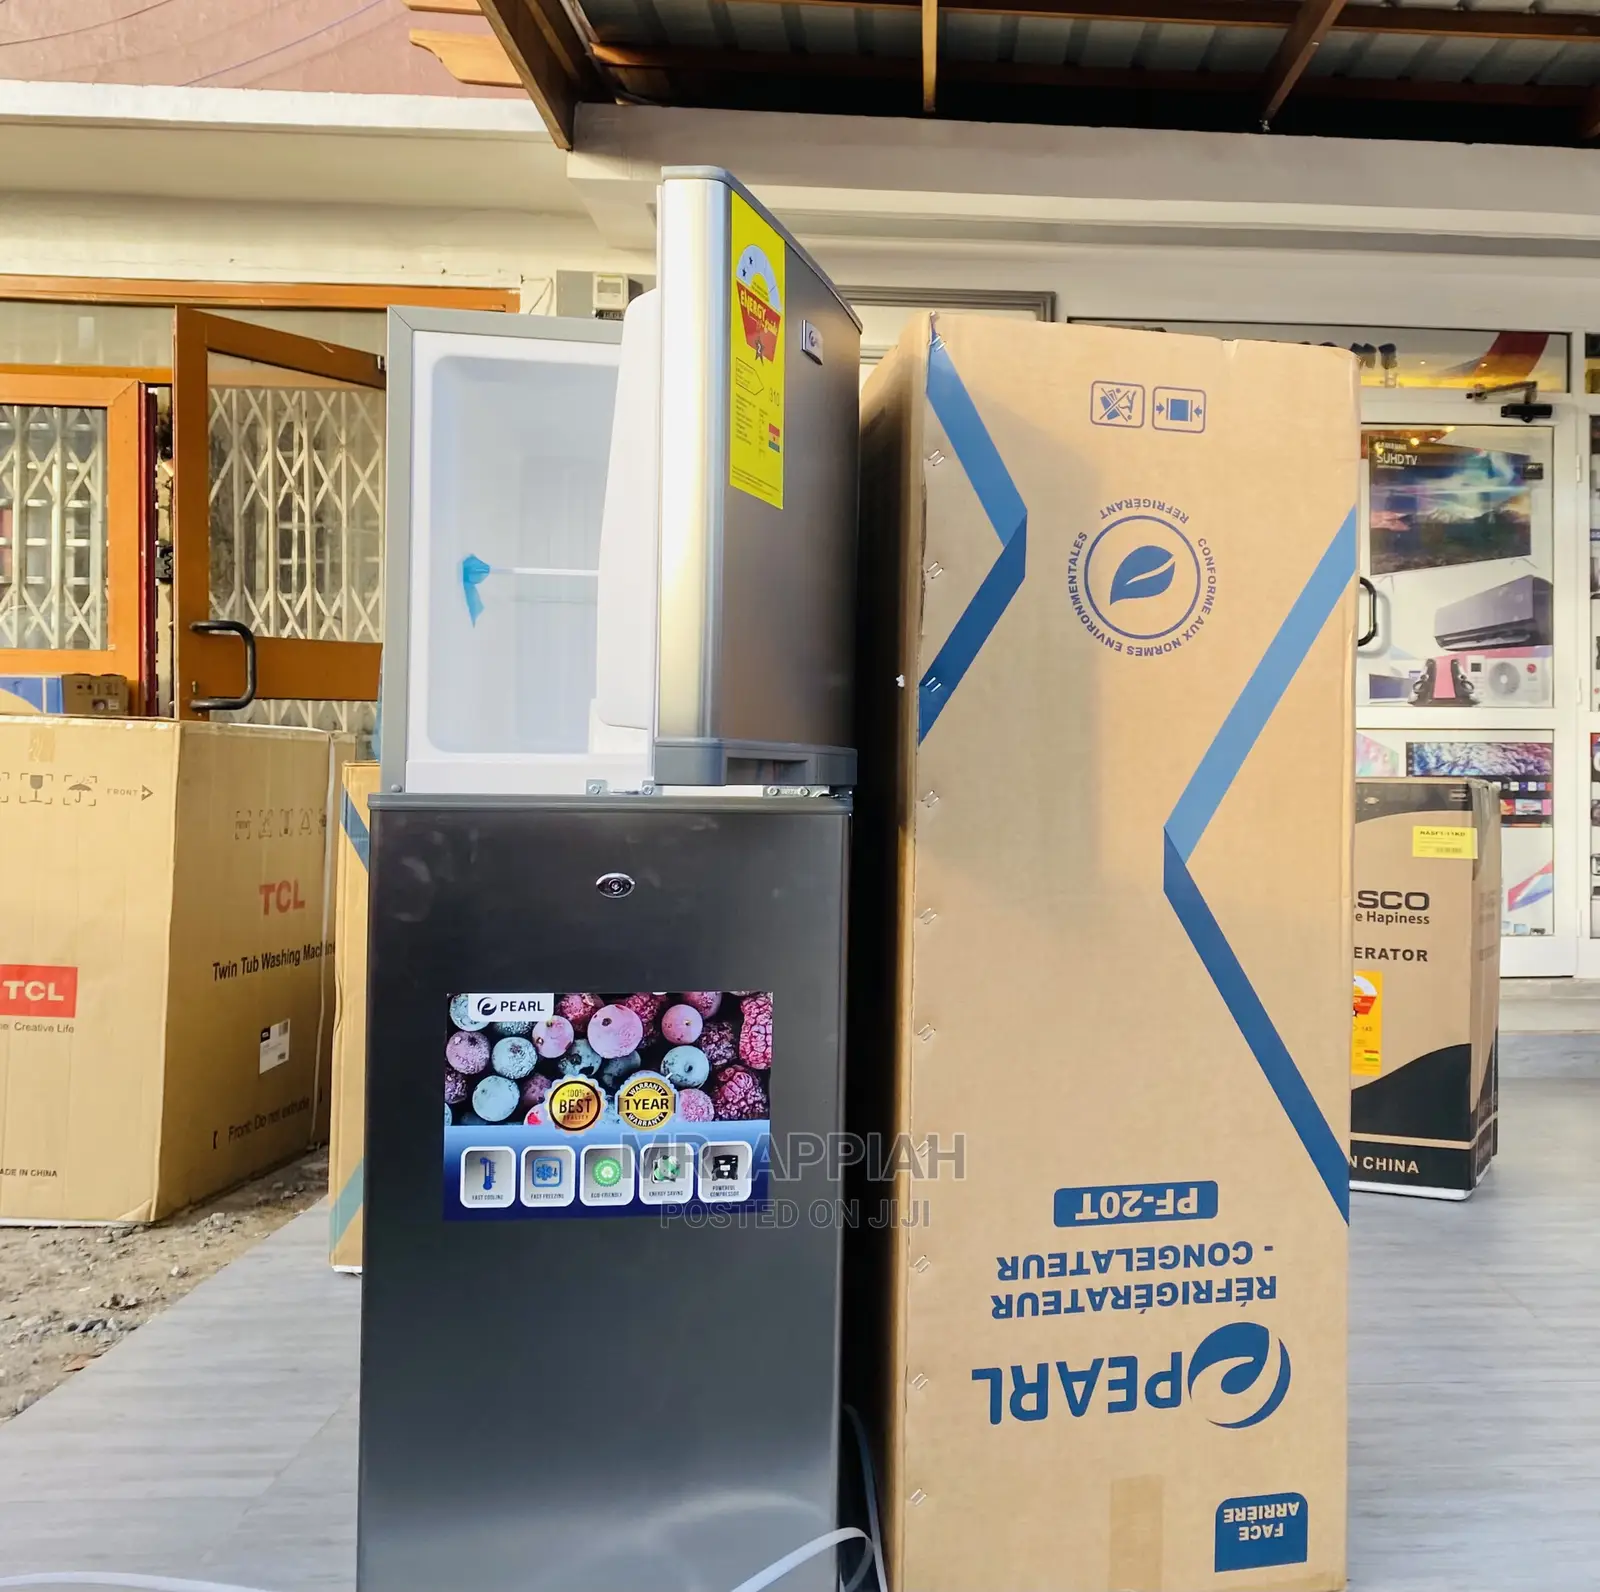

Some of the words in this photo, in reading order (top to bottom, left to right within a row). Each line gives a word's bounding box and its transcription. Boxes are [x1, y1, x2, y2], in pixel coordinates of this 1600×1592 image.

[1100, 498, 1189, 524] RÉFRIGÉRANT
[1197, 538, 1217, 615] CONFORME
[1067, 531, 1123, 652] ENVIRONMENTALES
[1182, 615, 1205, 641] AUX
[1126, 638, 1182, 656] NORMES
[107, 788, 139, 797] FRONT
[258, 879, 306, 916] TCL
[1353, 890, 1430, 911] SCO
[1366, 911, 1430, 926] Hapiness
[212, 960, 238, 982] Twin
[240, 955, 260, 975] Tub
[261, 947, 301, 967] Washing
[2, 980, 64, 1002] TCL
[500, 1000, 545, 1012] PEARL
[14, 1020, 54, 1033] Creative
[57, 1022, 75, 1034] Life
[567, 1089, 586, 1098] 100%
[629, 1081, 666, 1097] WARRANTY
[559, 1098, 593, 1114] BEST
[623, 1099, 630, 1111] 1
[633, 1098, 669, 1111] YEAR
[628, 1112, 666, 1127] WARRANTY
[19, 1168, 28, 1178] IN
[30, 1168, 58, 1178] CHINA
[1362, 1156, 1420, 1174] CHINA
[1074, 1186, 1199, 1222] PF-20T
[995, 1240, 1254, 1281] CONGELATEUR
[990, 1275, 1277, 1320] RÉFRIGÉRATEUR
[971, 1351, 1184, 1425] PEARL
[1238, 1523, 1284, 1541] FACE
